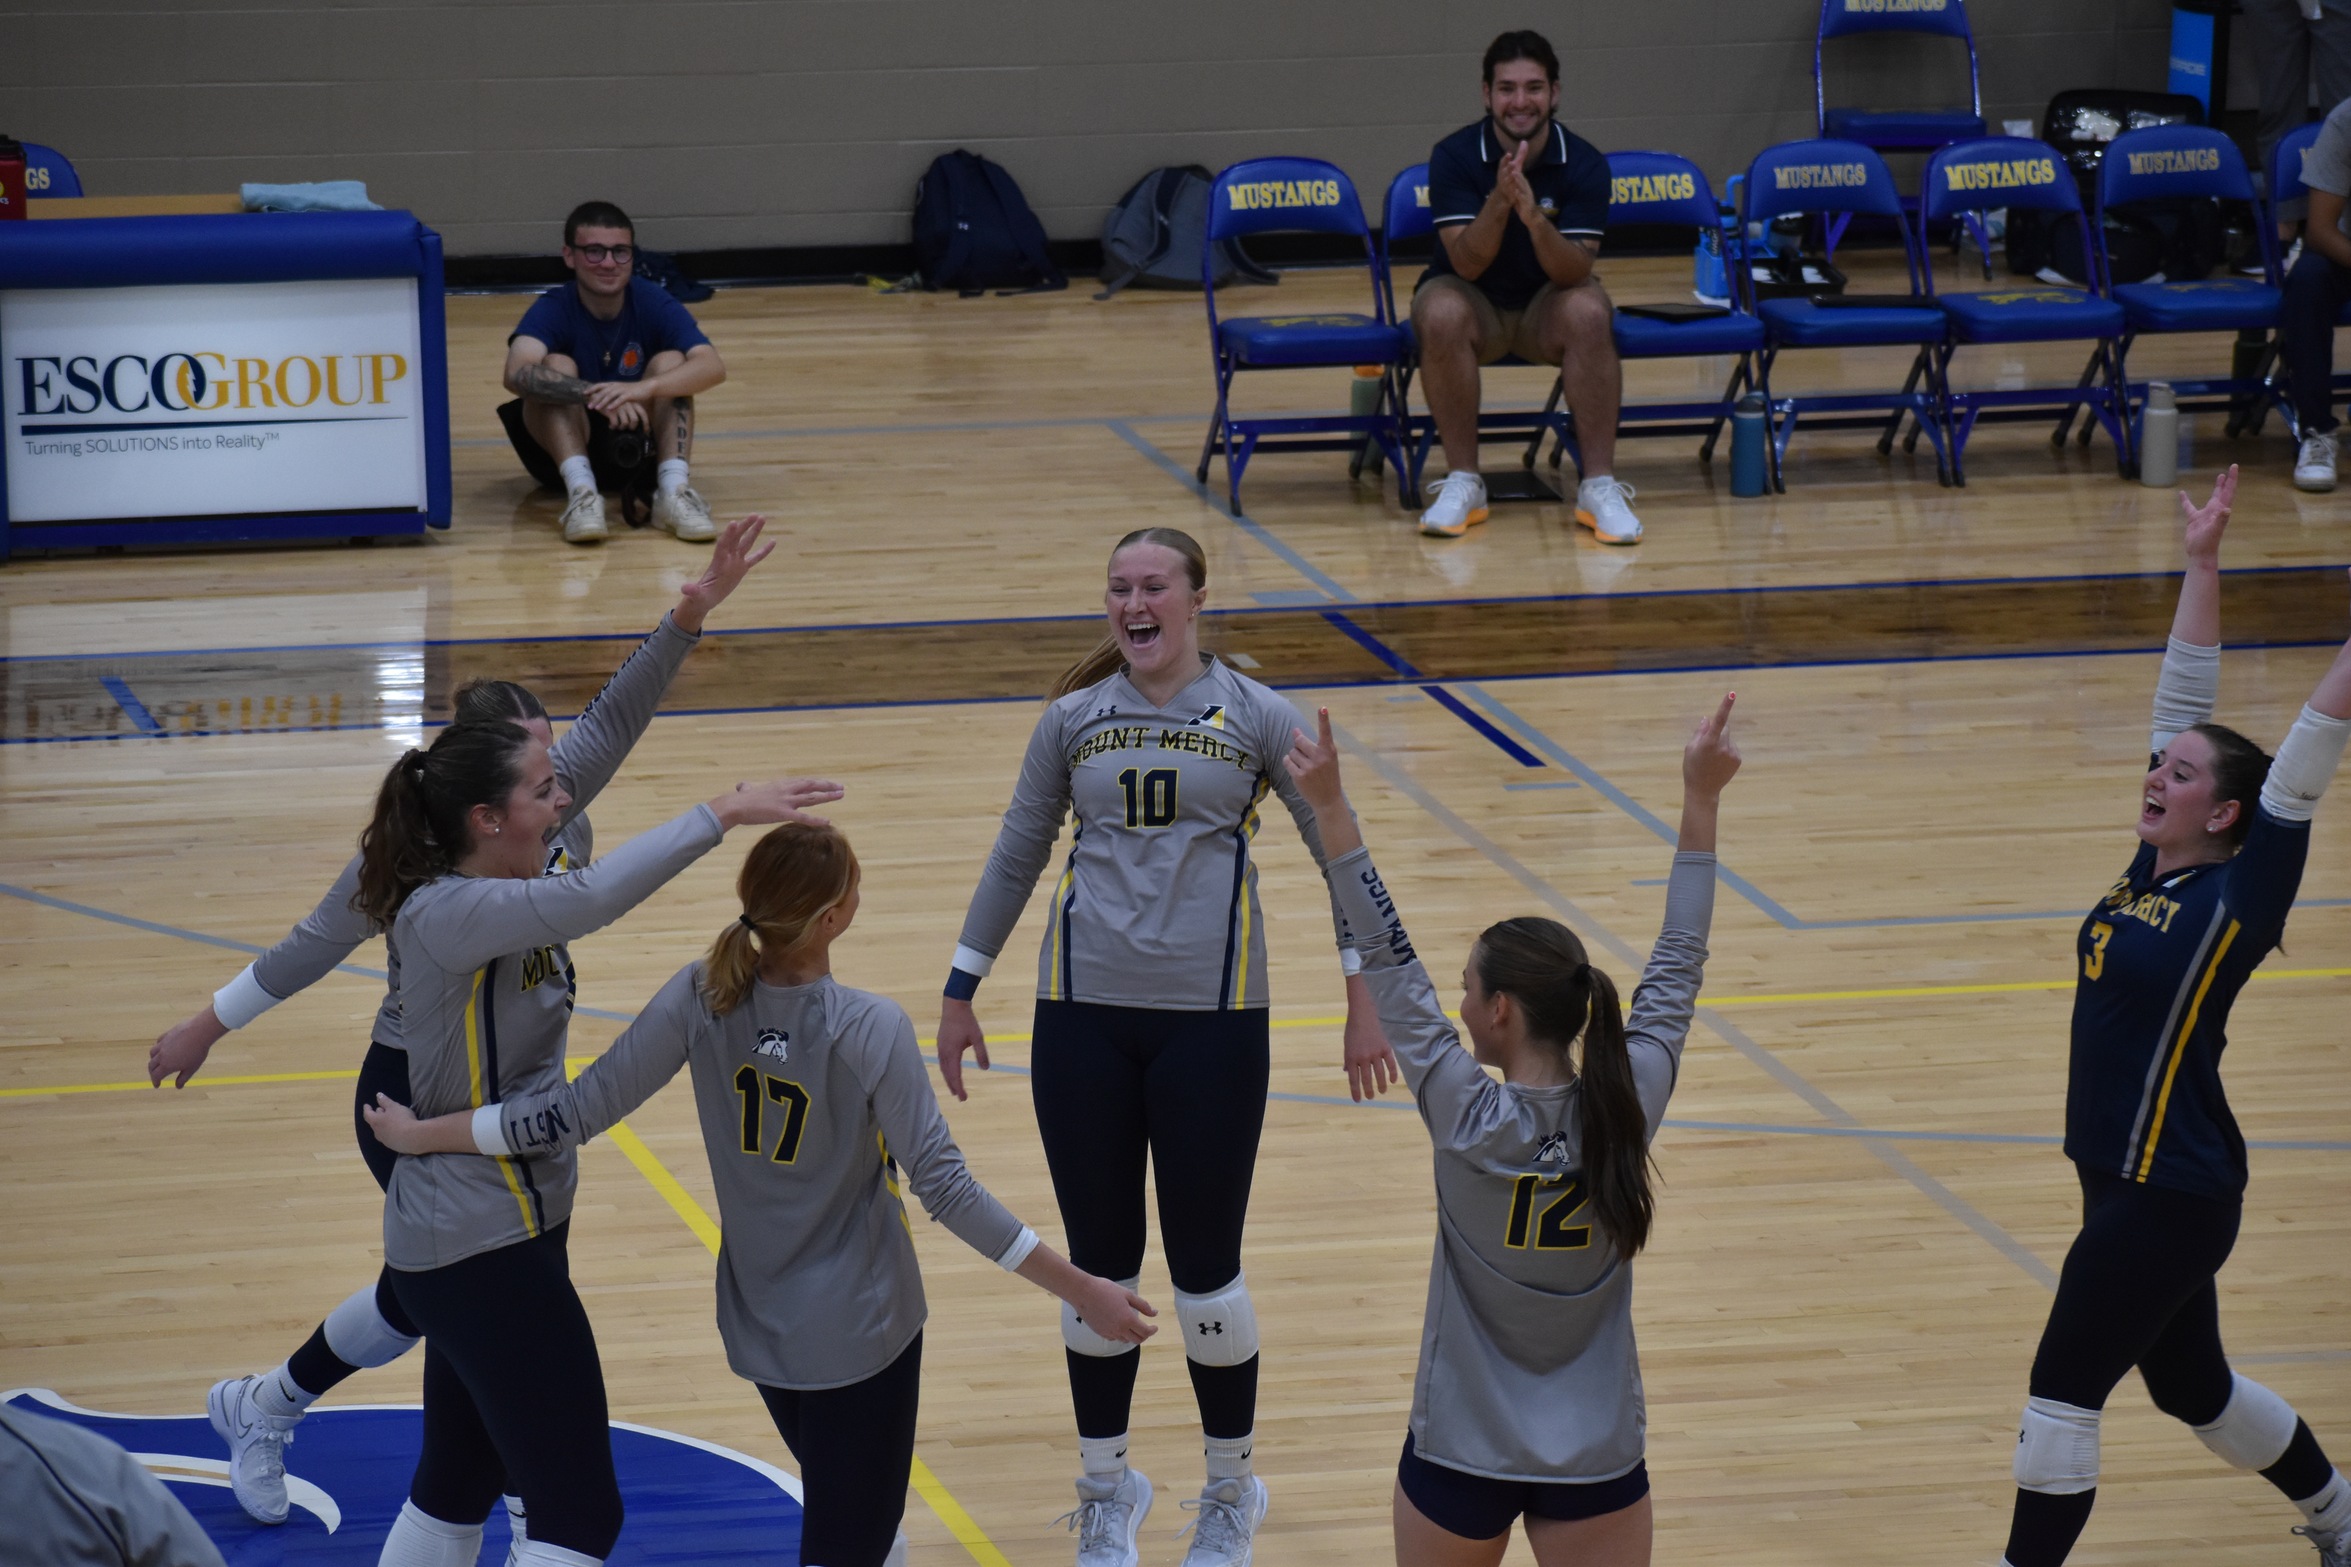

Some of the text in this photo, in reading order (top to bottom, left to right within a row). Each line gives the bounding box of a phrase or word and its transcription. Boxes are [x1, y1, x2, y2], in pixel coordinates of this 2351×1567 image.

[1774, 163, 1867, 189] MUSTANGS
[1944, 159, 2056, 191] MUSTANGS
[2128, 147, 2220, 175] MUSTANGS
[1227, 180, 1341, 210] MUSTANGS
[25, 441, 82, 456] Turning
[86, 436, 179, 453] SOLUTIONS
[182, 436, 212, 450] into
[1159, 729, 1250, 770] MERCY
[1117, 767, 1180, 829] 10
[2084, 919, 2114, 981] 3
[733, 1063, 812, 1165] 17
[1503, 1172, 1592, 1250] 12
